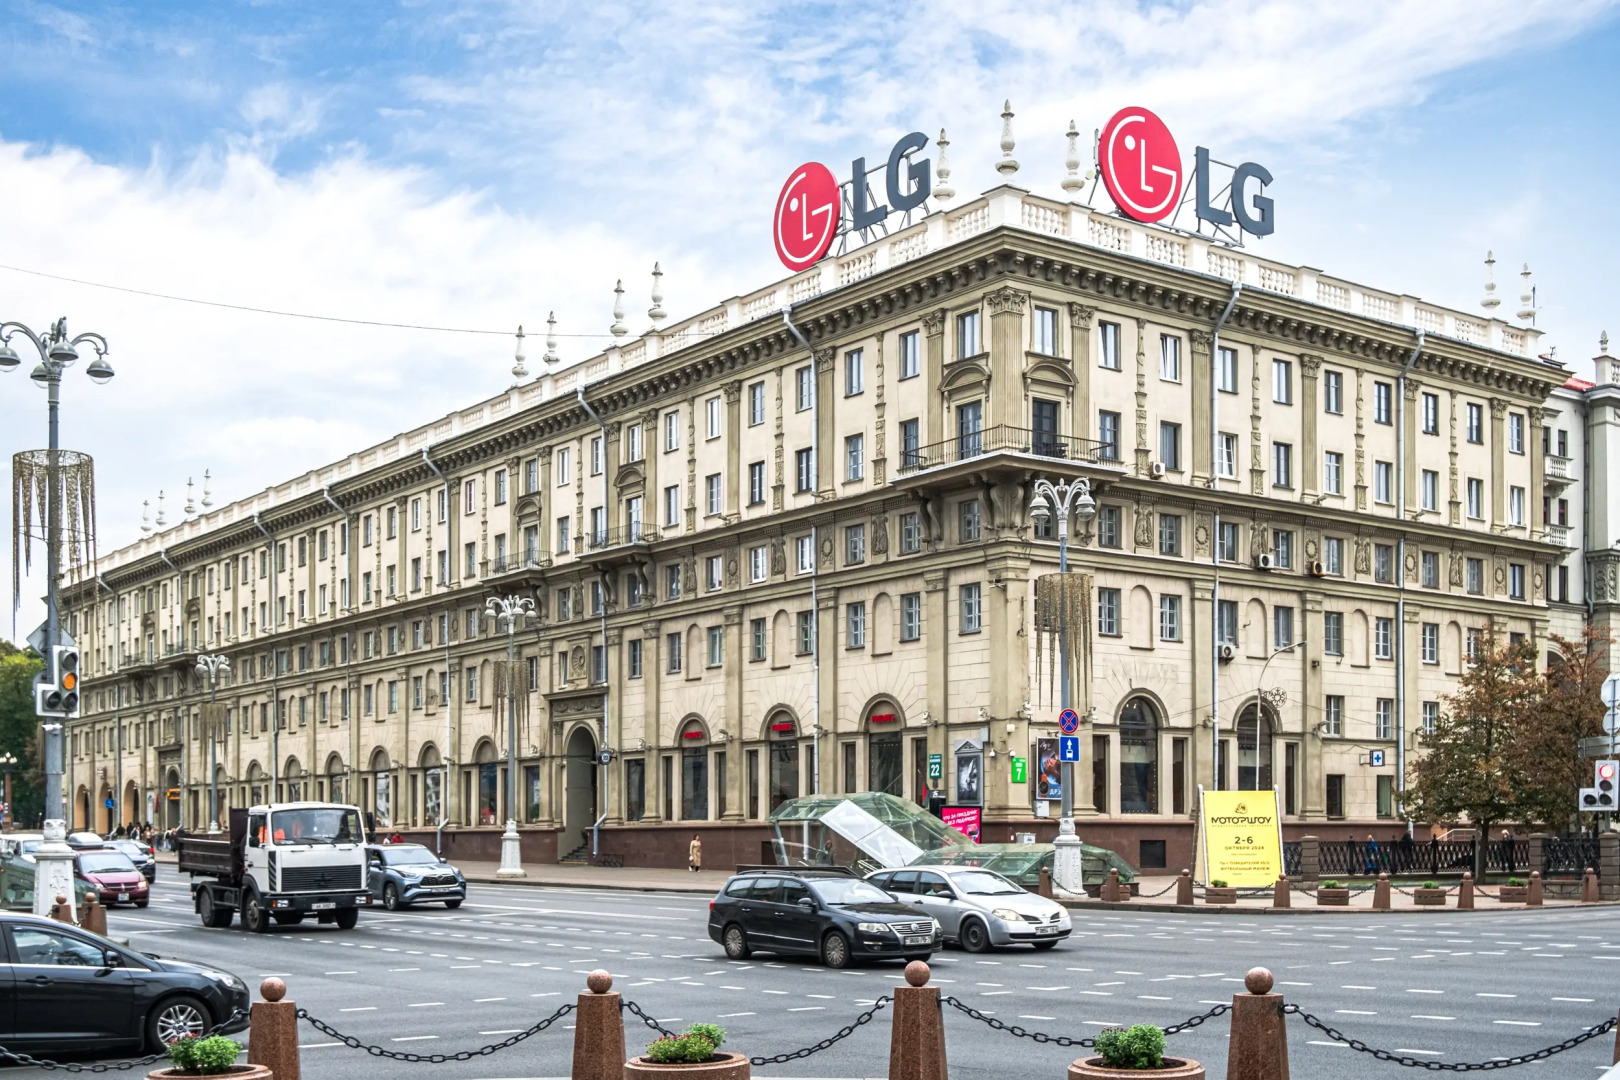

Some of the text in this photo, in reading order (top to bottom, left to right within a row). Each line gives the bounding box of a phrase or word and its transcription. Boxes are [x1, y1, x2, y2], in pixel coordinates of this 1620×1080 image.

[851, 131, 931, 232] LG
[1195, 145, 1275, 236] LG
[930, 764, 940, 777] 22
[1016, 768, 1022, 781] 7
[1211, 816, 1272, 824] МОТОРШОУ
